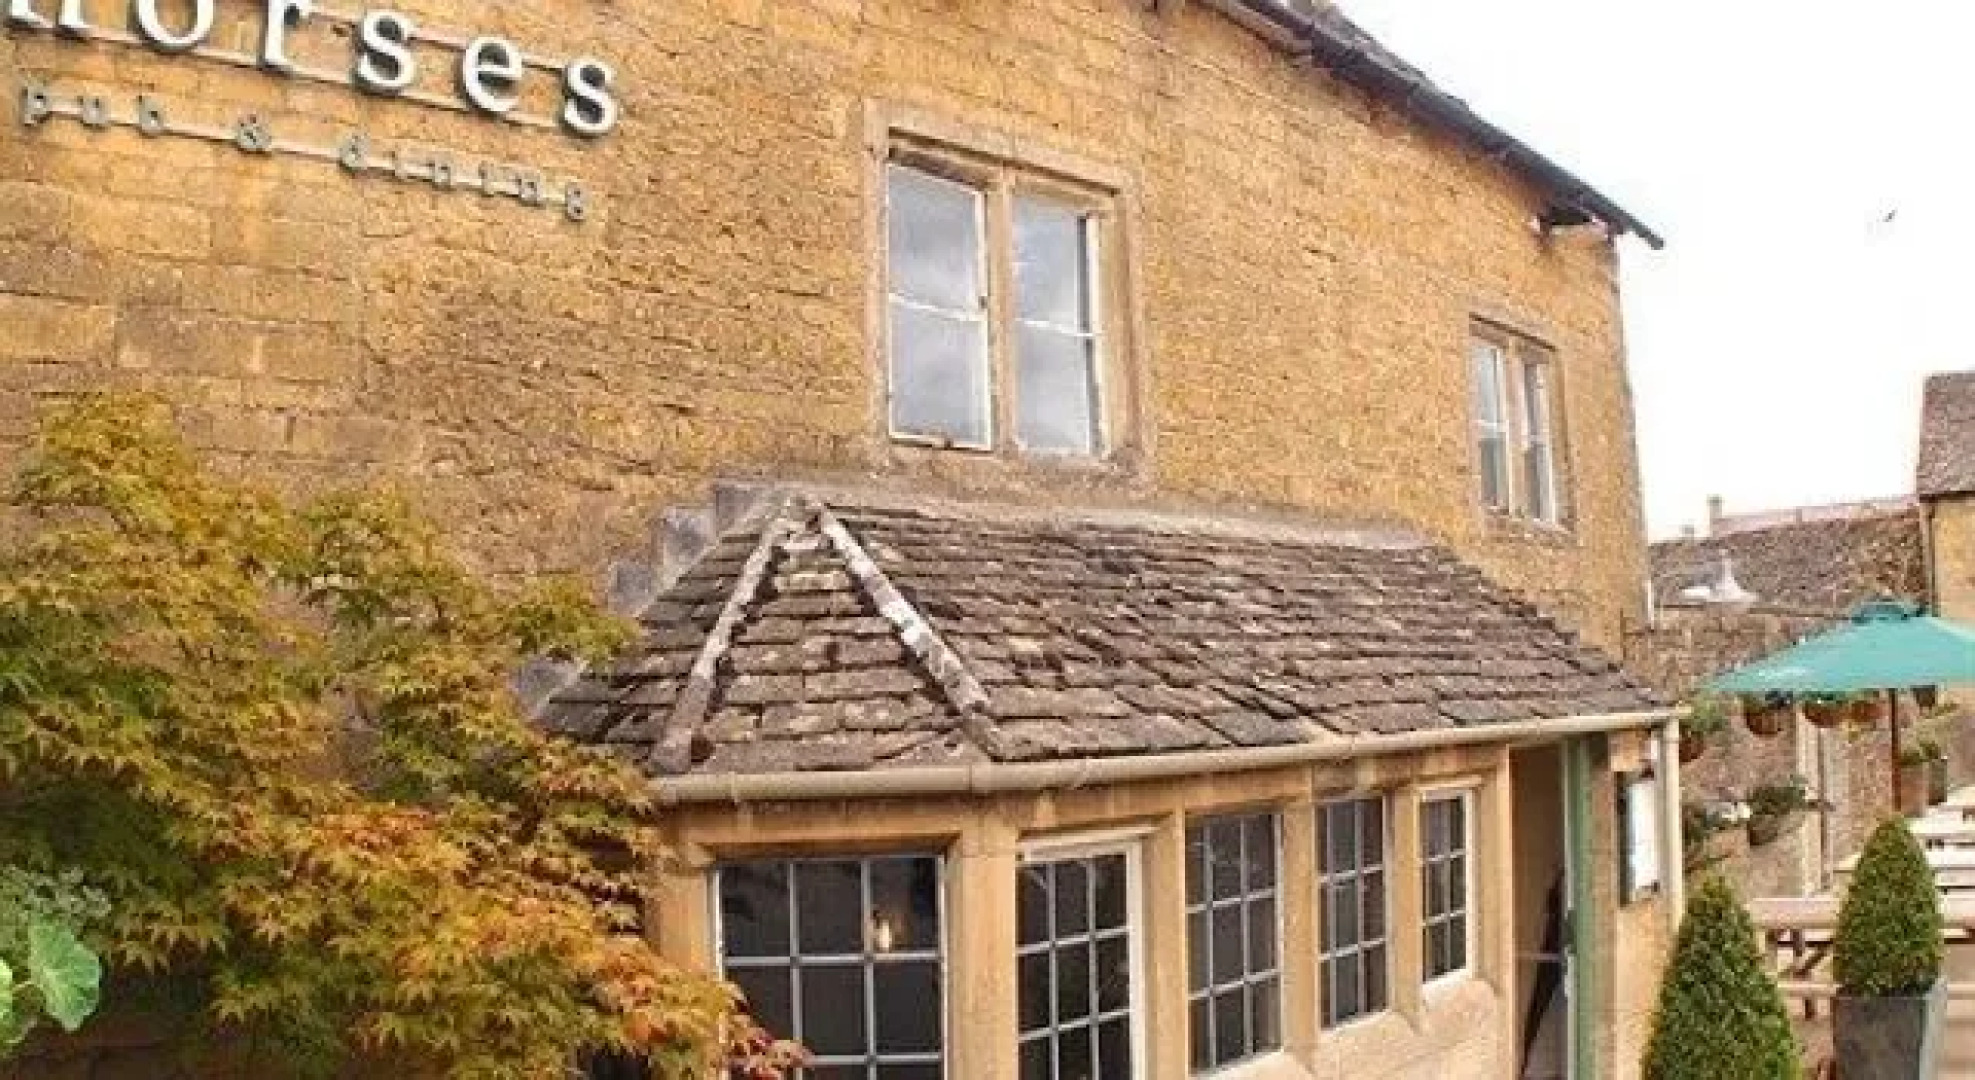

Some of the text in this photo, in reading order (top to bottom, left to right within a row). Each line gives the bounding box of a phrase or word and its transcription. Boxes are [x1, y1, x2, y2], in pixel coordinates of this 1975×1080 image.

[8, 0, 617, 134] orses
[22, 82, 587, 221] pub & dining
